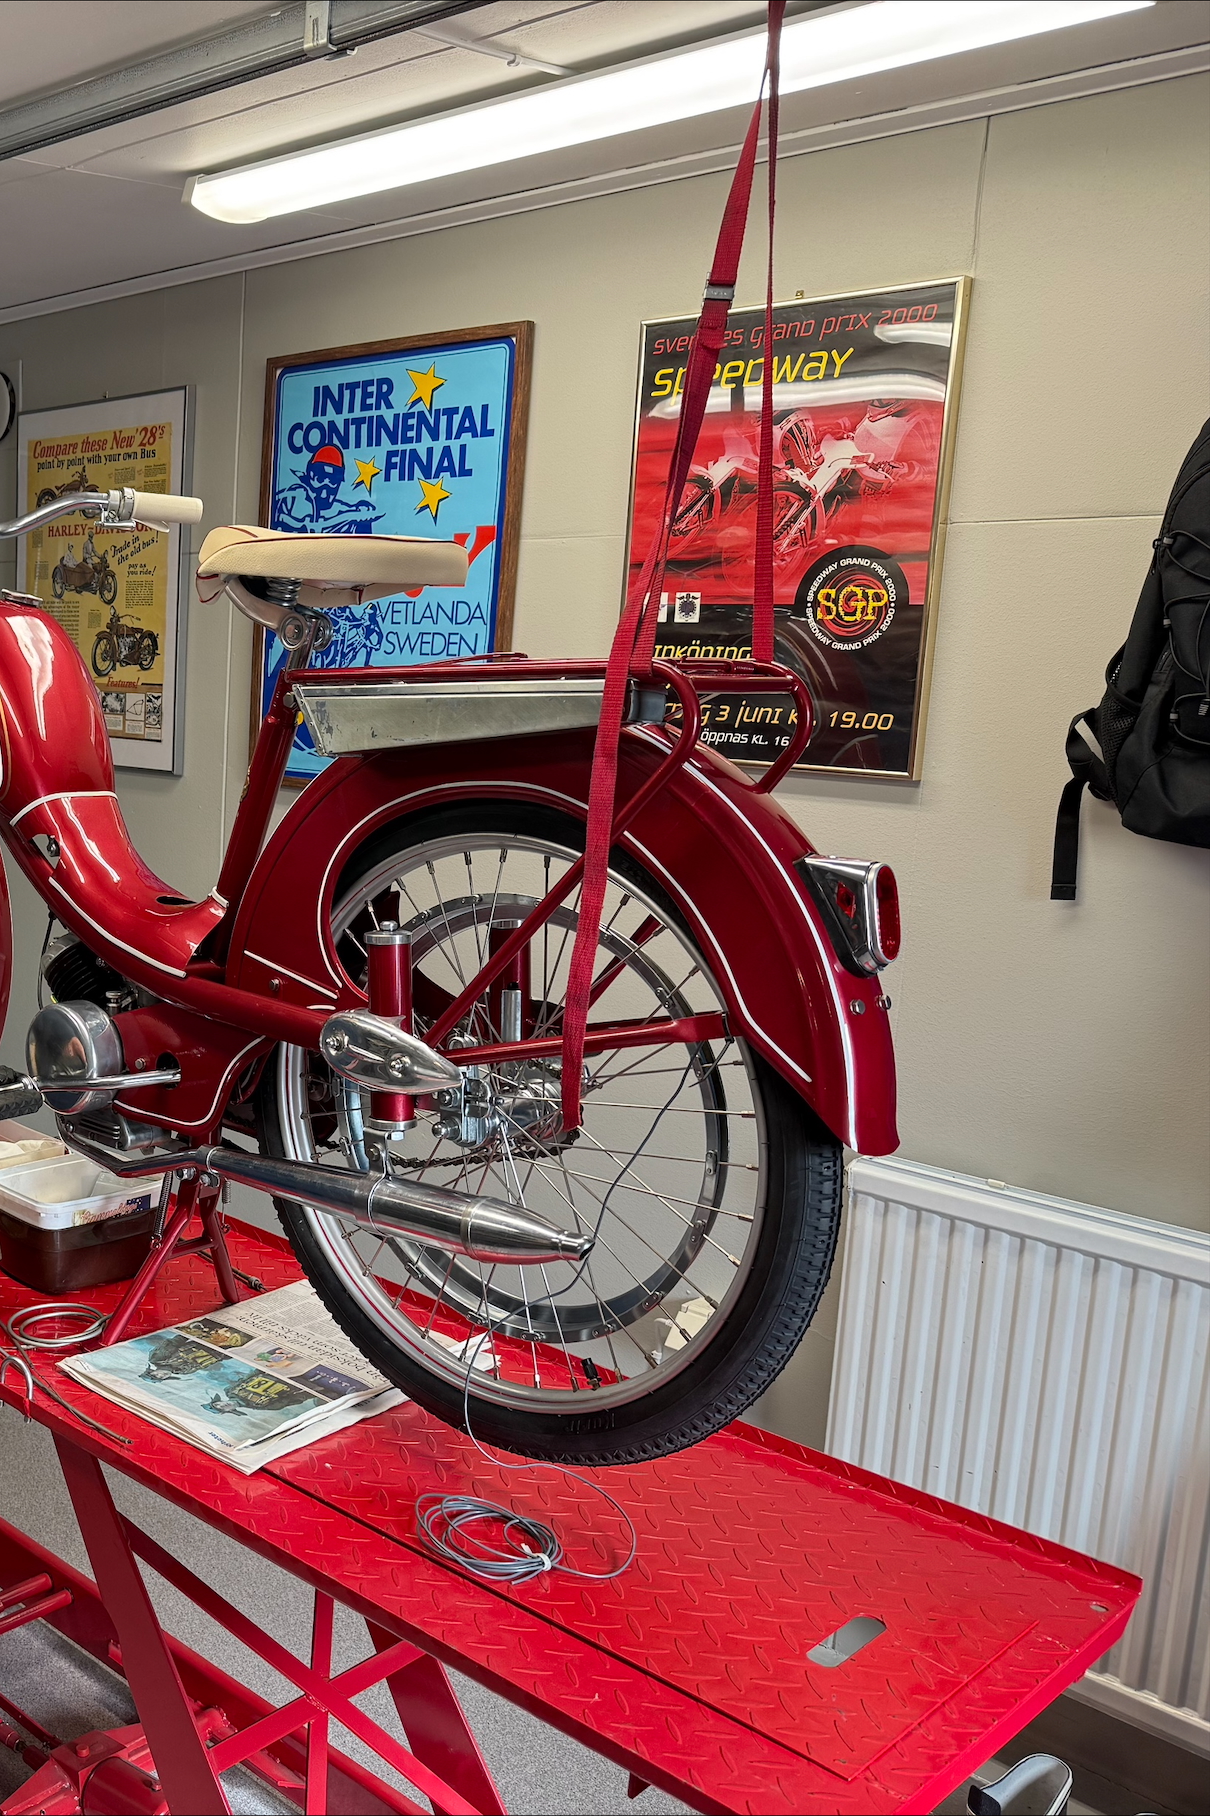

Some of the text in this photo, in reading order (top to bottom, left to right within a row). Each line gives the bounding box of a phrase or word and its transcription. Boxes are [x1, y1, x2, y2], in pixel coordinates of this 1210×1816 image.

[878, 303, 938, 327] 2000
[312, 377, 394, 418] INTER
[287, 404, 495, 455] CONTINENTAL
[33, 440, 79, 460] Compare
[81, 436, 108, 453] these
[110, 430, 135, 450] New
[37, 448, 156, 472] point by point with your own Bus
[383, 444, 473, 482] FINAL
[110, 540, 131, 558] Trade
[117, 554, 129, 565] the
[130, 543, 141, 557] old
[806, 557, 897, 602] SPEEDWAY GRAND PRIX 2000
[375, 600, 487, 626] VETLANDA
[816, 585, 889, 622] SGP
[806, 607, 896, 651] SPEEDWAY GRAND PRIX 2000
[383, 631, 479, 657] SWEDEN
[106, 677, 140, 689] Features!
[715, 704, 731, 722] 3
[734, 700, 784, 729] juni
[829, 710, 894, 731] 19.00
[700, 727, 749, 744] öppnas
